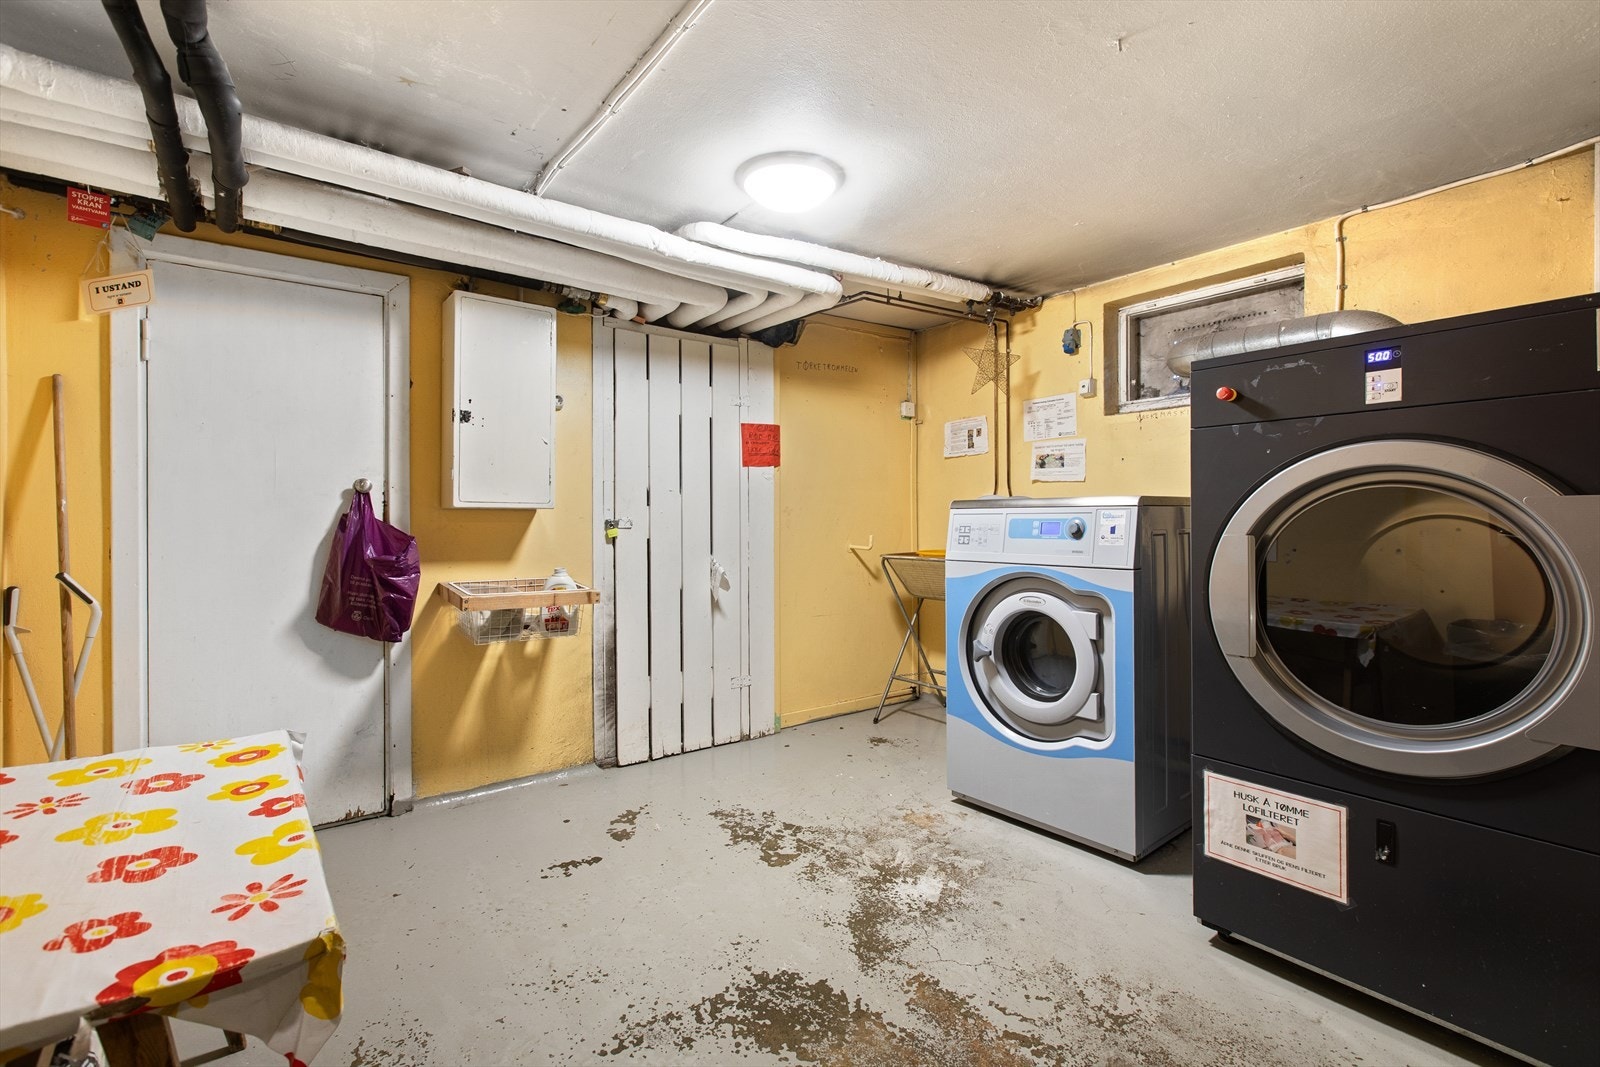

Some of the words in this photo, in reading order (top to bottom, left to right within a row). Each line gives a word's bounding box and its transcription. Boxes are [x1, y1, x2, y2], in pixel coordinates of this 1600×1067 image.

[71, 191, 108, 204] STOPPE-
[71, 203, 108, 216] VARMTVANN
[77, 199, 102, 210] KRAN
[102, 280, 142, 293] USTAND
[1233, 790, 1259, 804] HUSK
[1262, 797, 1271, 807] Å
[1275, 801, 1310, 819] TØMME
[1242, 803, 1300, 826] LOFILTERET
[1234, 844, 1251, 854] DENNE
[1252, 850, 1276, 862] SKUFFEN
[1285, 861, 1300, 871] RENS
[1301, 867, 1326, 879] FILTERET
[1255, 857, 1271, 866] ETTER
